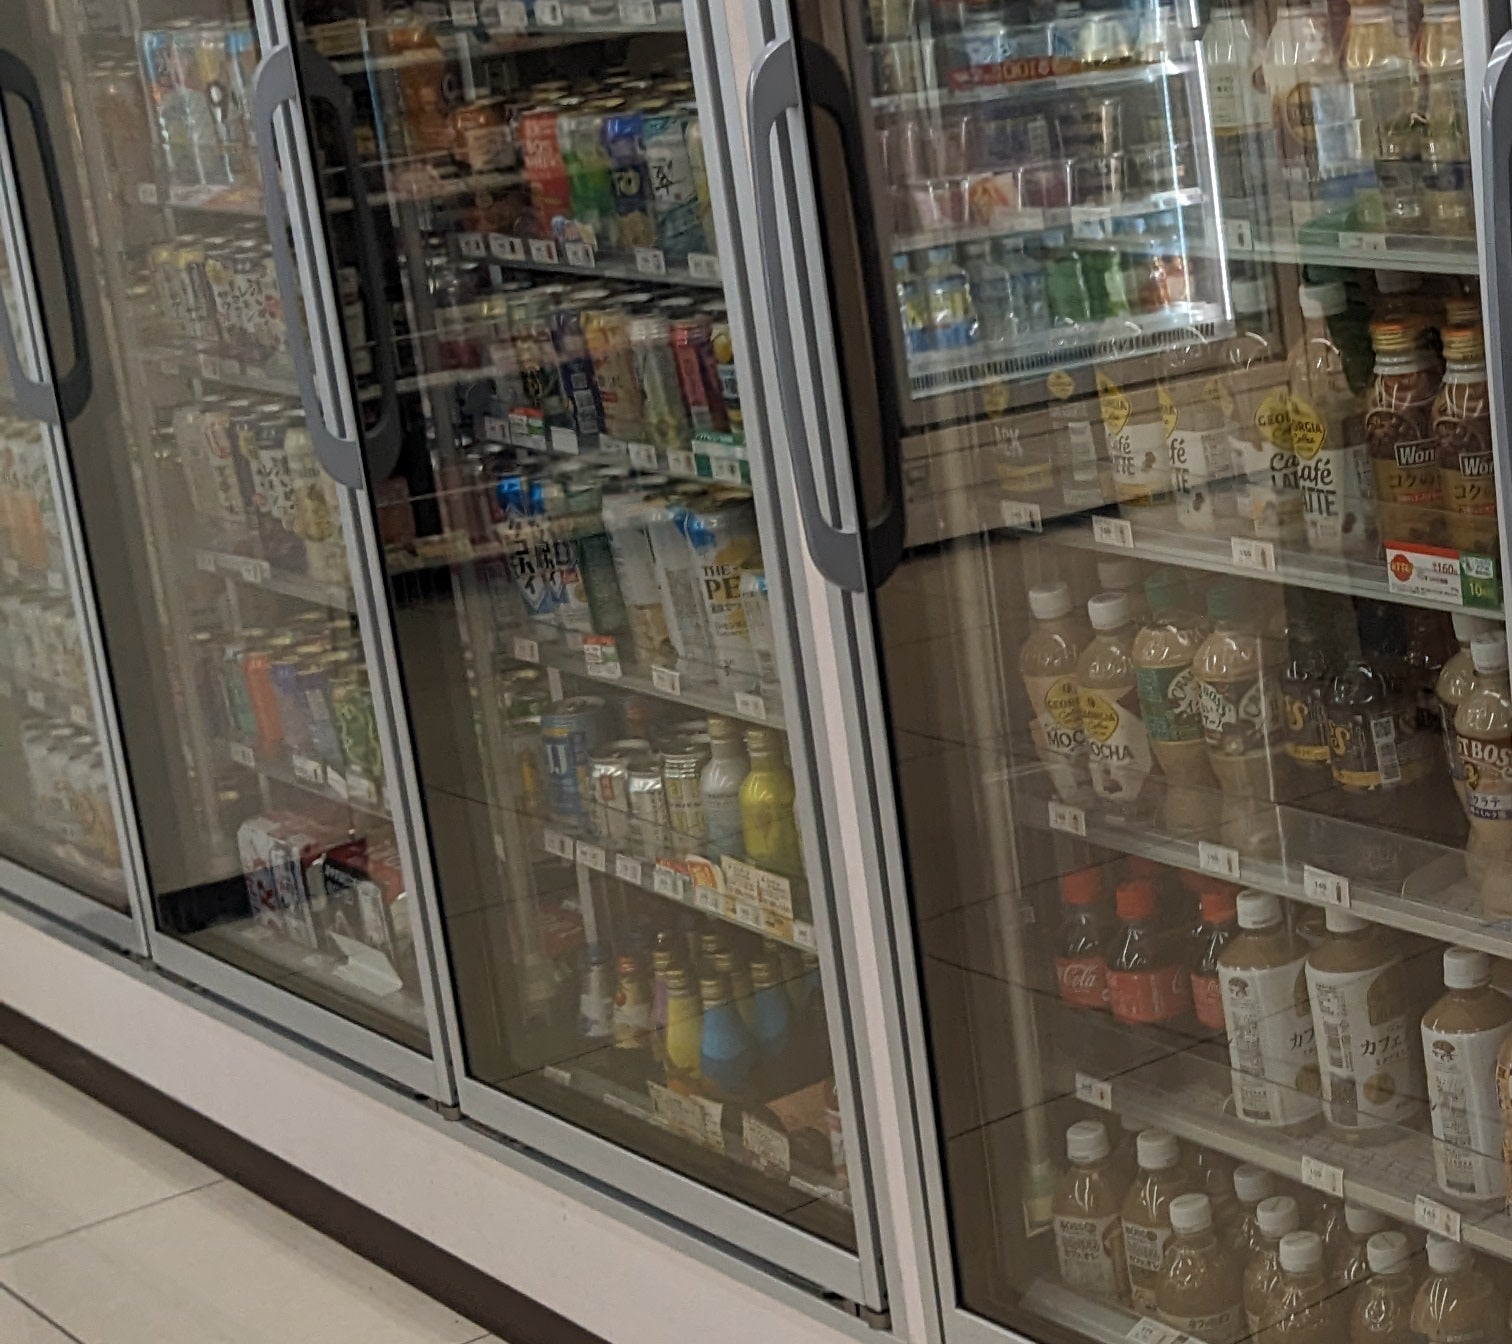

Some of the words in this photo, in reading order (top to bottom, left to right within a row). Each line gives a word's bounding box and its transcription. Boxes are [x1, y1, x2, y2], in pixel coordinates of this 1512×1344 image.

[1400, 446, 1436, 466] Won
[1300, 458, 1333, 486] afé
[1301, 487, 1338, 517] ATTE
[1088, 740, 1133, 761] OCHA
